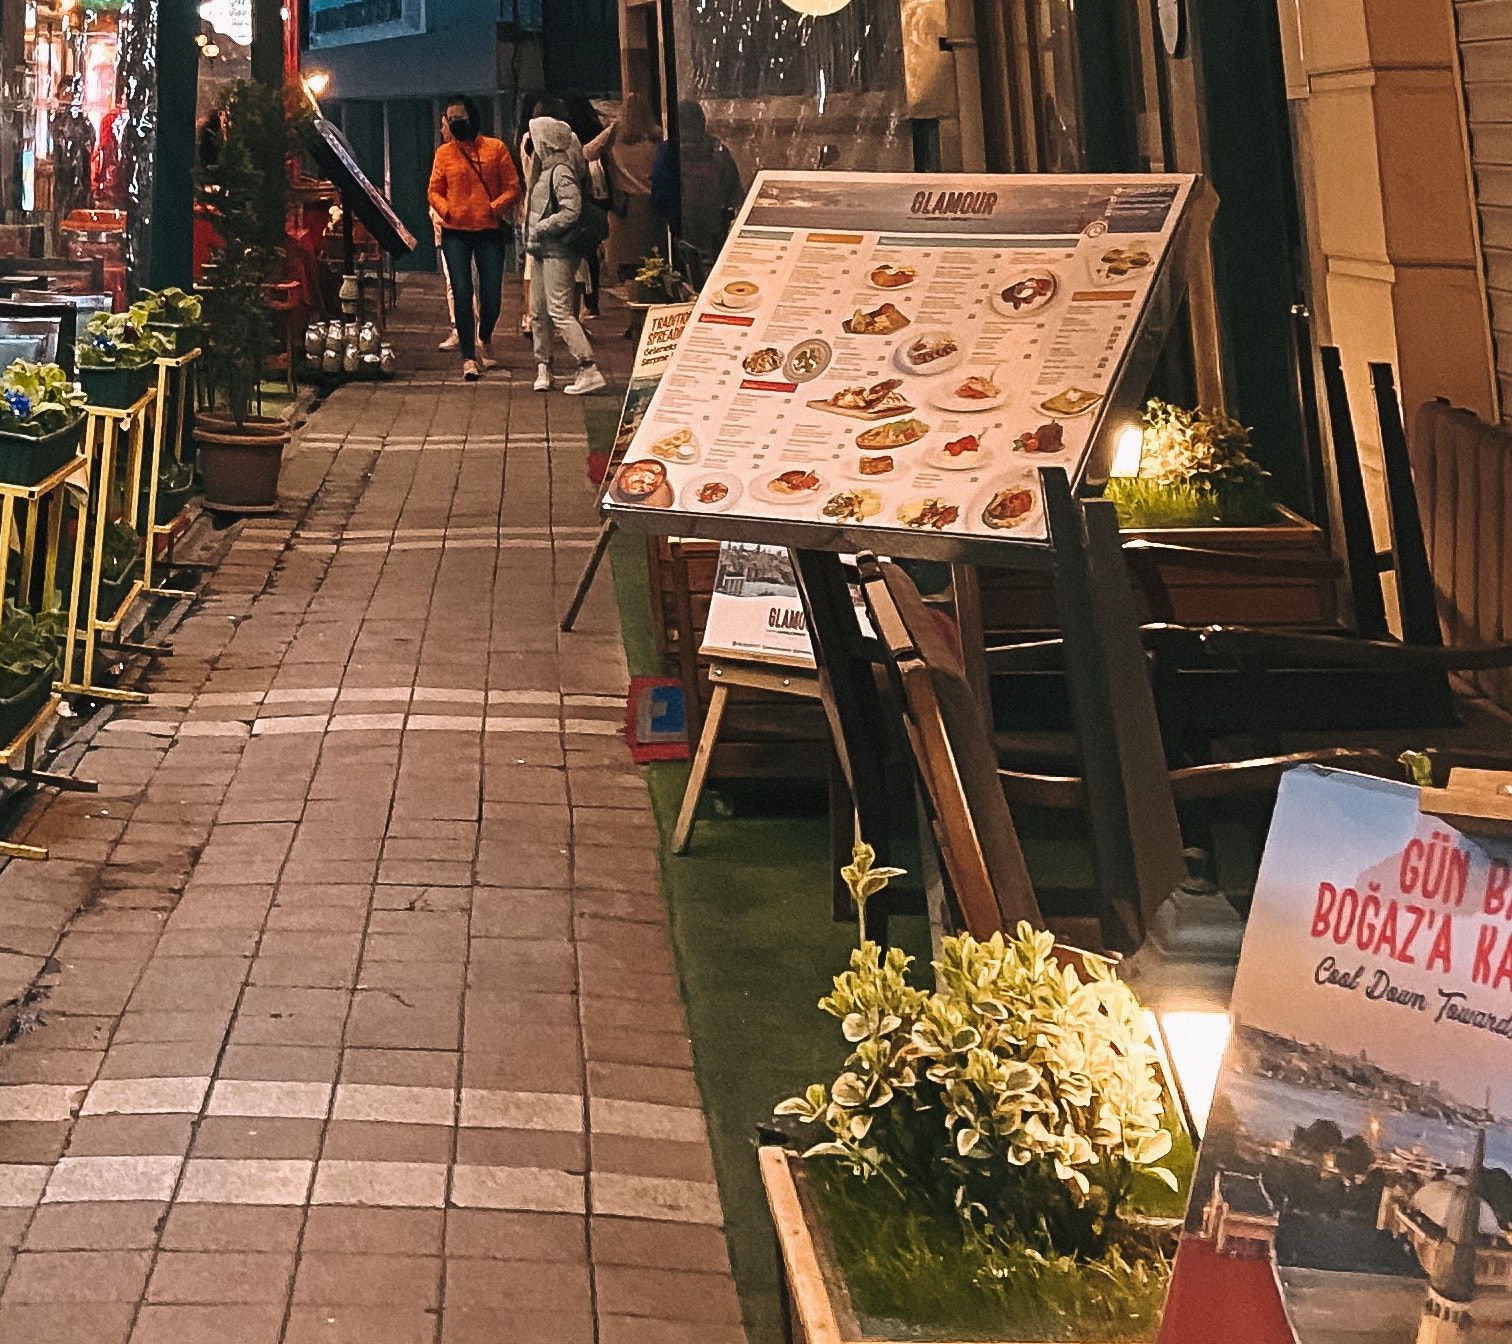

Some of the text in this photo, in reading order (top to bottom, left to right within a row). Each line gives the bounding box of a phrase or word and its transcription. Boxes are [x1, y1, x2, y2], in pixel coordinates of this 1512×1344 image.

[910, 190, 998, 215] GLAMOUR
[768, 607, 806, 630] GLAMO
[1399, 830, 1512, 921] GÜN B
[1310, 880, 1453, 974] BOĞAZ'A
[1314, 955, 1366, 990] Cool
[1365, 968, 1429, 1012] Down
